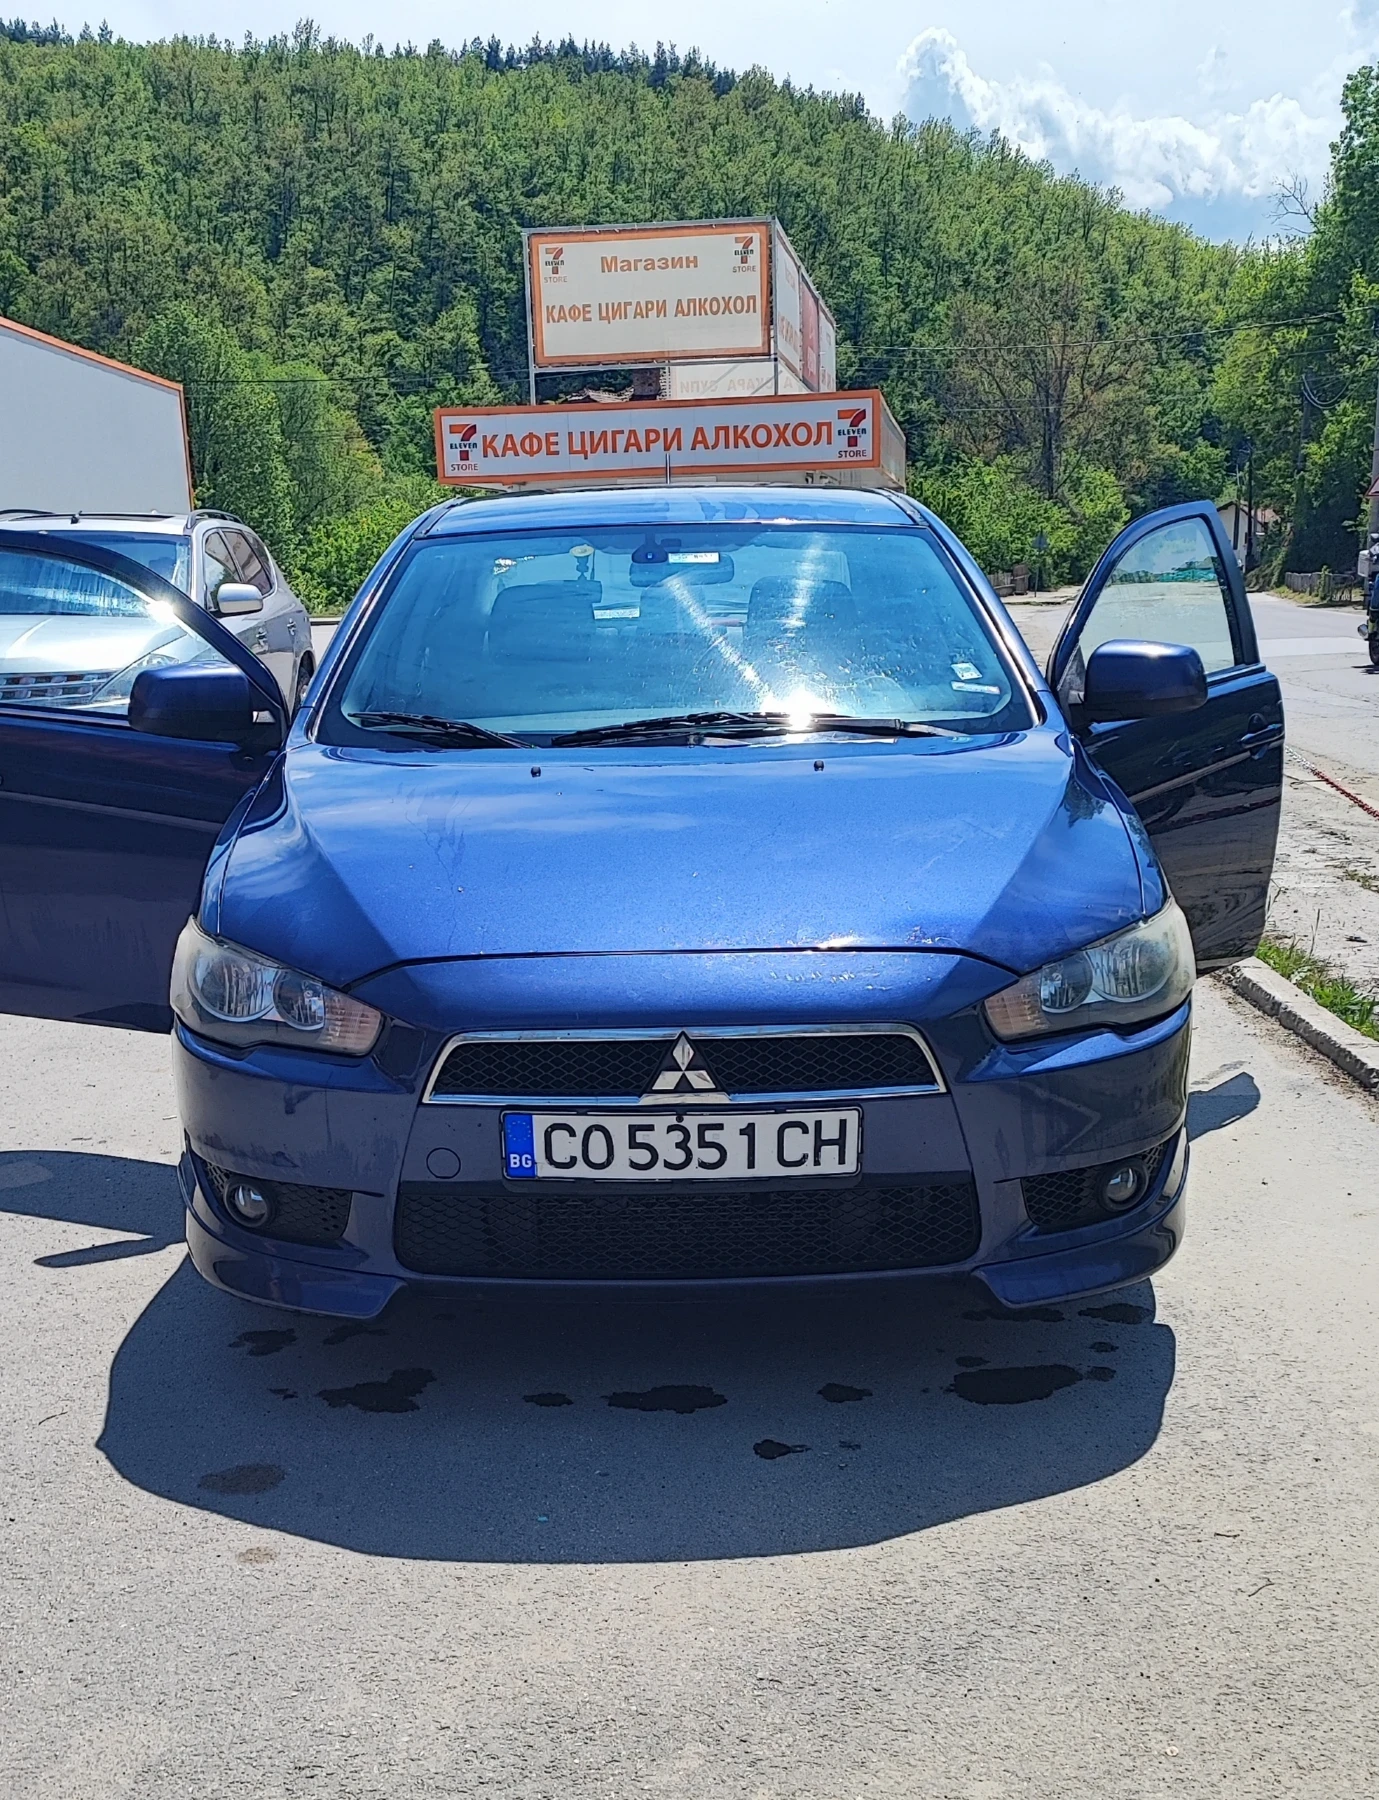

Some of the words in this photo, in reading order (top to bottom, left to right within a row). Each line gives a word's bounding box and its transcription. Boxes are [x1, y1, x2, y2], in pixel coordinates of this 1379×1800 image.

[600, 255, 699, 273] Магазин
[732, 265, 757, 274] STORE
[546, 303, 592, 323] КАФЕ
[598, 299, 668, 324] ЦИГАРИ
[674, 295, 758, 317] АЛКОХОЛ
[838, 408, 867, 447] 7
[449, 424, 477, 461] 7
[482, 432, 560, 458] КАФЕ
[567, 427, 682, 460] ЦИГАРИ
[690, 421, 833, 451] АЛКОХОЛ
[837, 449, 867, 459] STORE
[450, 463, 479, 471] STORE
[627, 1121, 756, 1171] 5351
[776, 1118, 847, 1169] CH
[509, 1153, 532, 1168] BG
